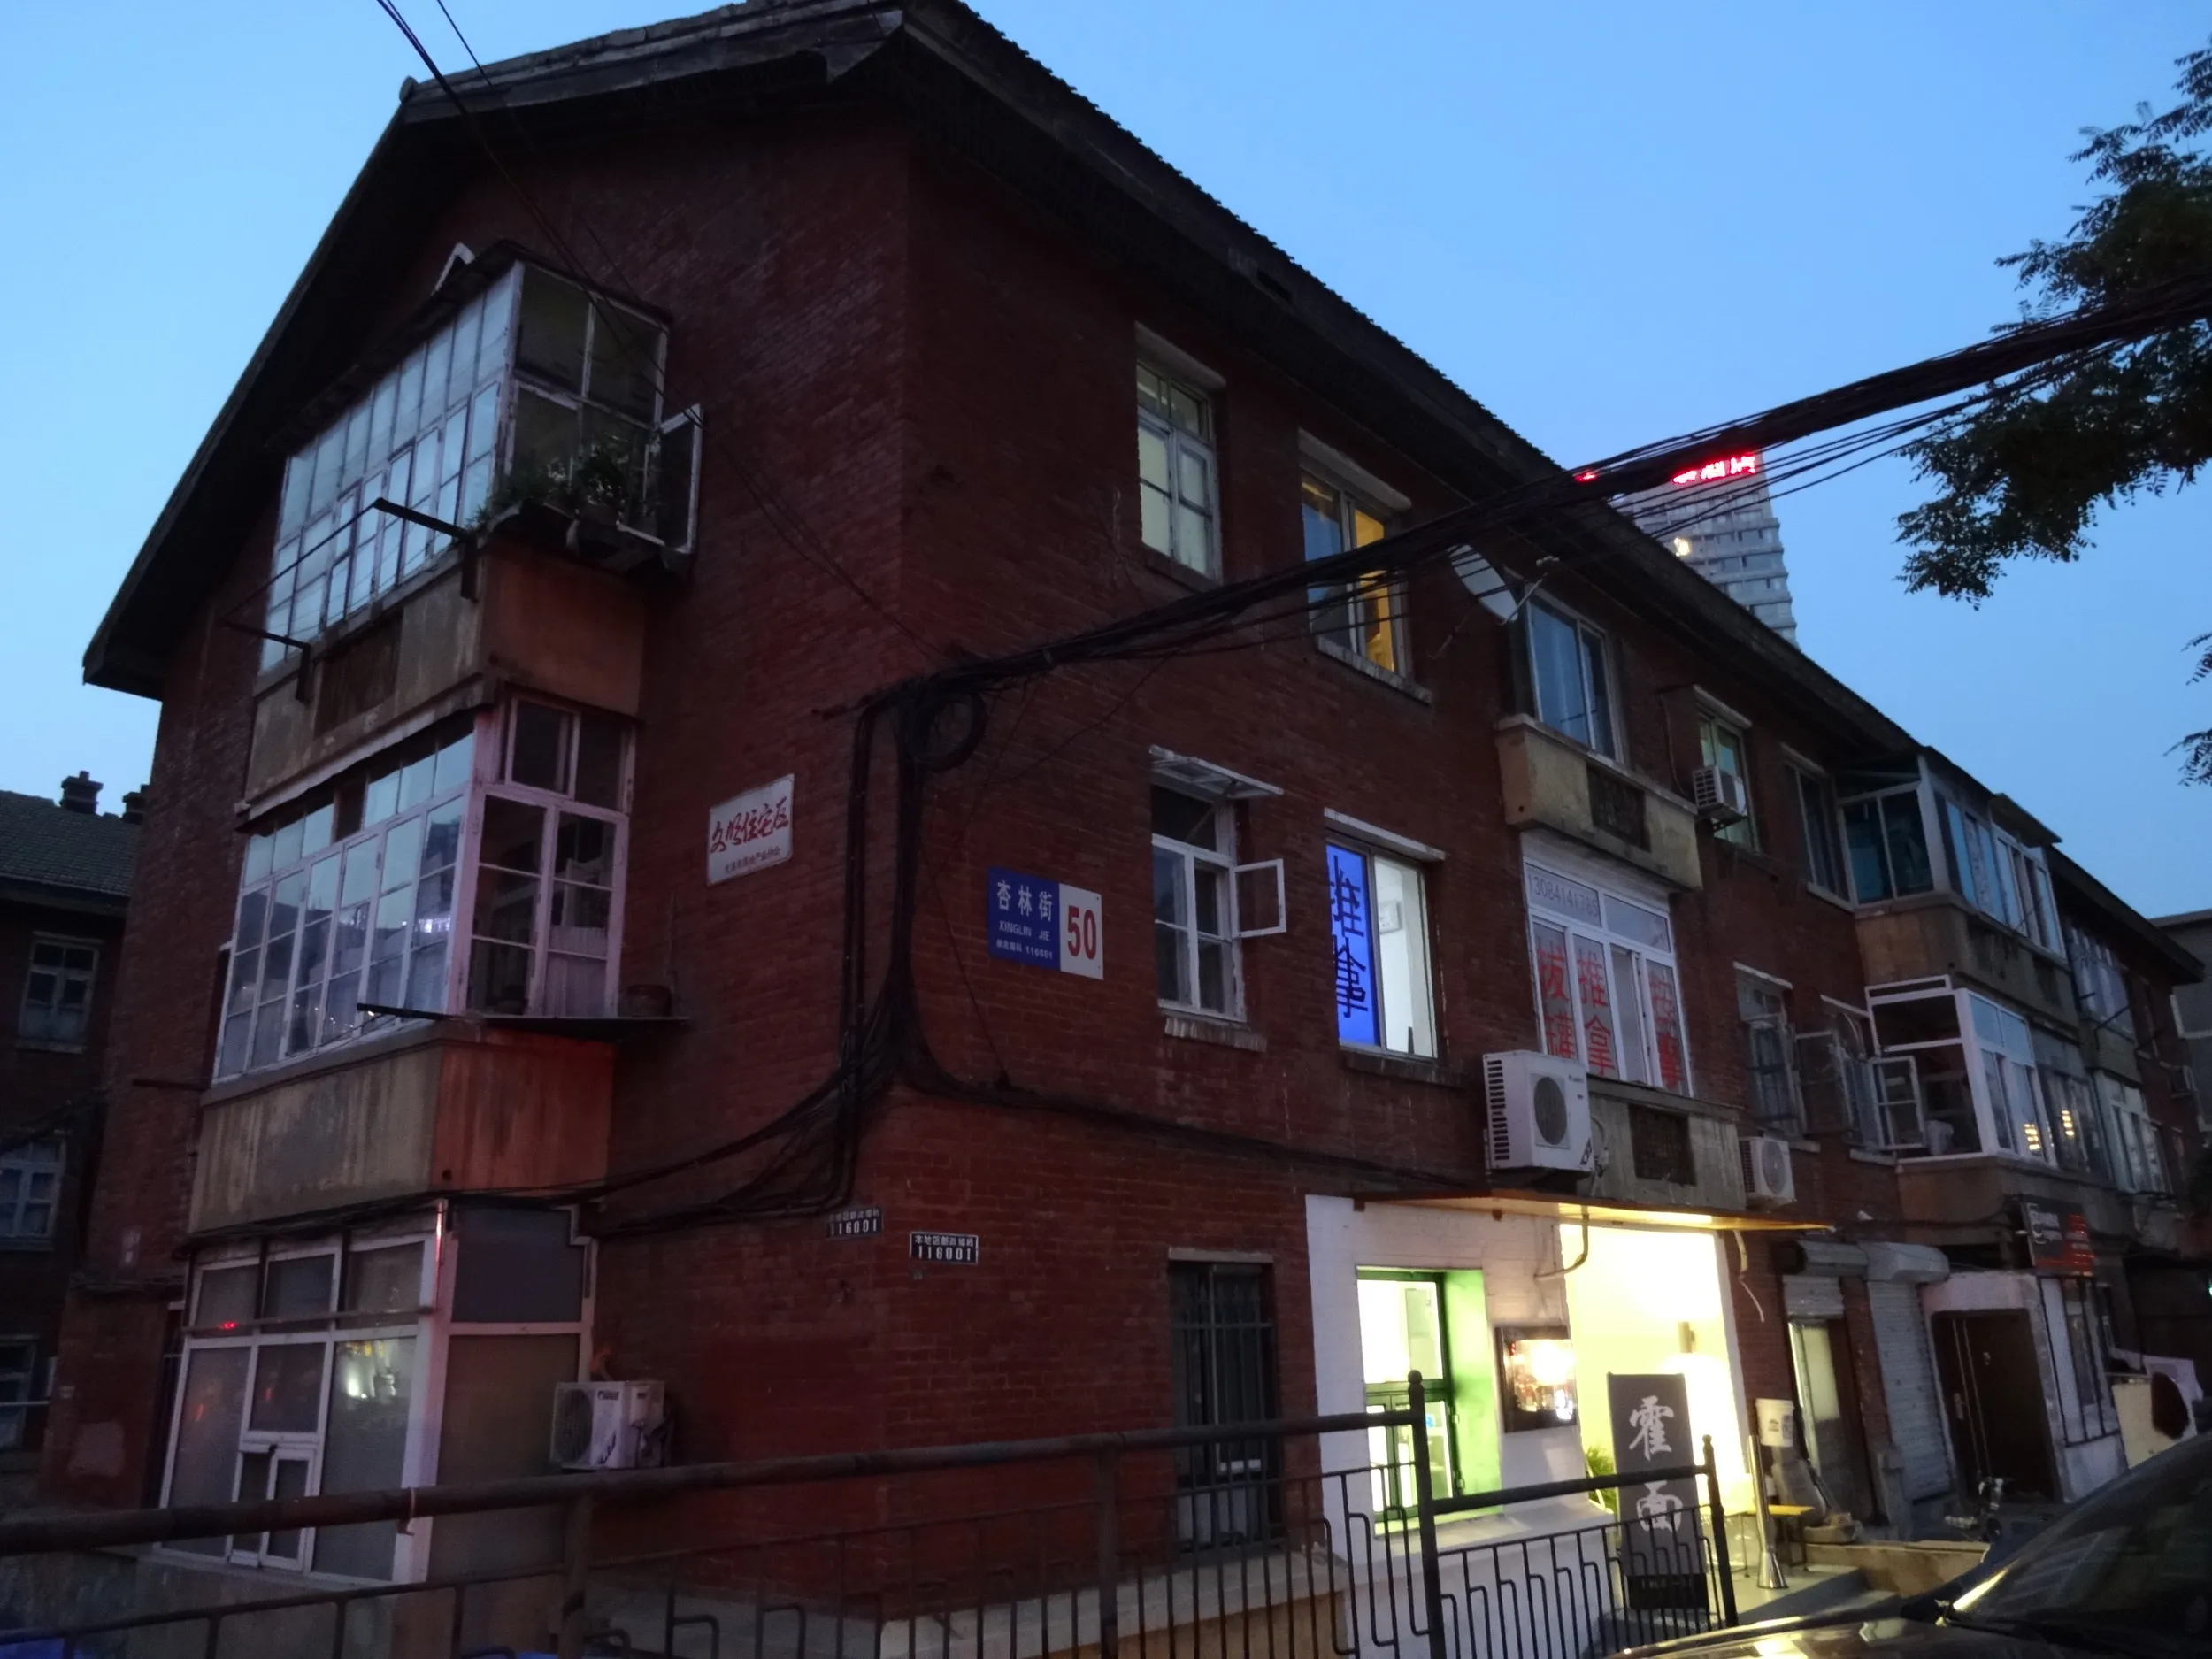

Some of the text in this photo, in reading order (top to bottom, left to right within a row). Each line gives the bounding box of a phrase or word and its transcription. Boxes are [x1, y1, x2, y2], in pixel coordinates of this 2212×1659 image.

[996, 880, 1053, 922] 杏林街
[999, 920, 1050, 941] XINGLIN JIE
[1067, 905, 1097, 960] 50
[1579, 949, 1617, 1077] 推拿
[829, 1218, 878, 1236] 116001
[918, 1245, 972, 1261] 116001
